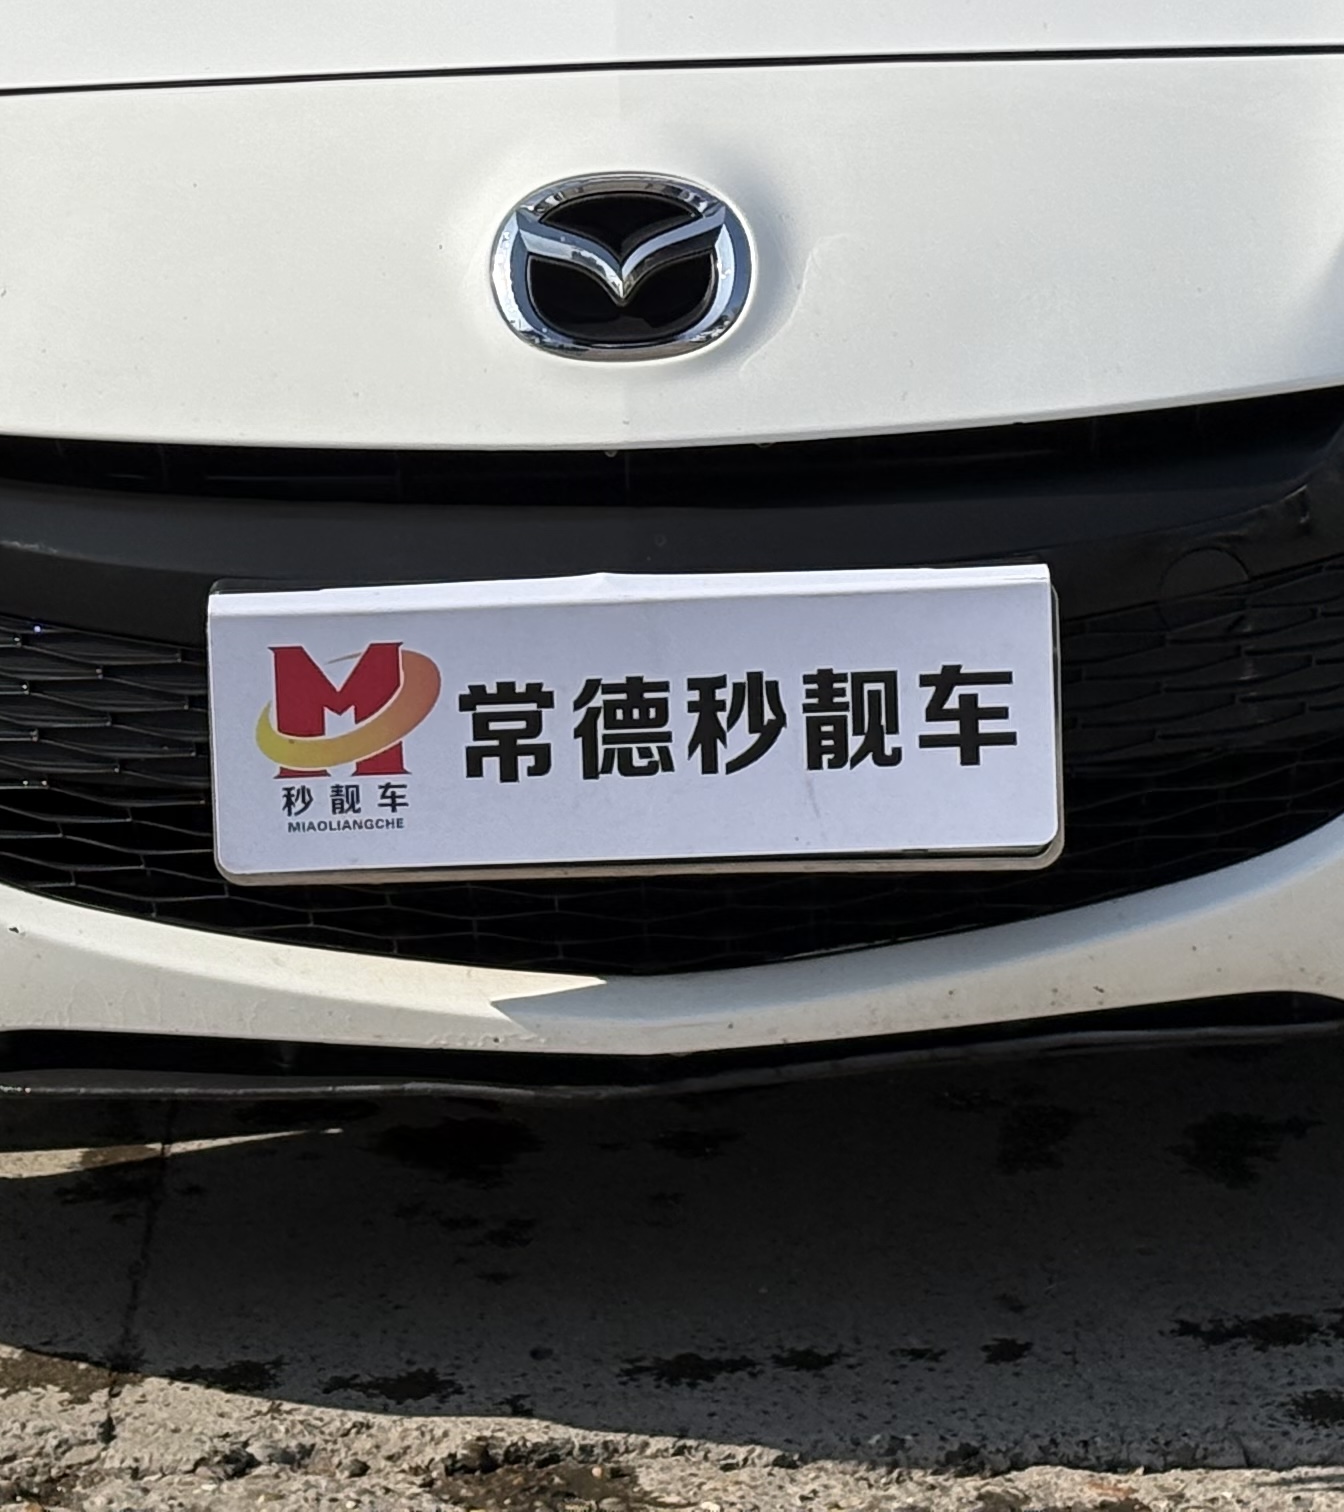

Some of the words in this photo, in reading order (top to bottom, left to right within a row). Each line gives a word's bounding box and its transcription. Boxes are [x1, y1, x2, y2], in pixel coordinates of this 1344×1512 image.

[457, 663, 1018, 784] 常德秒靓车
[281, 781, 410, 818] 秒靓车
[286, 817, 405, 834] MIAOLIANGCHE
